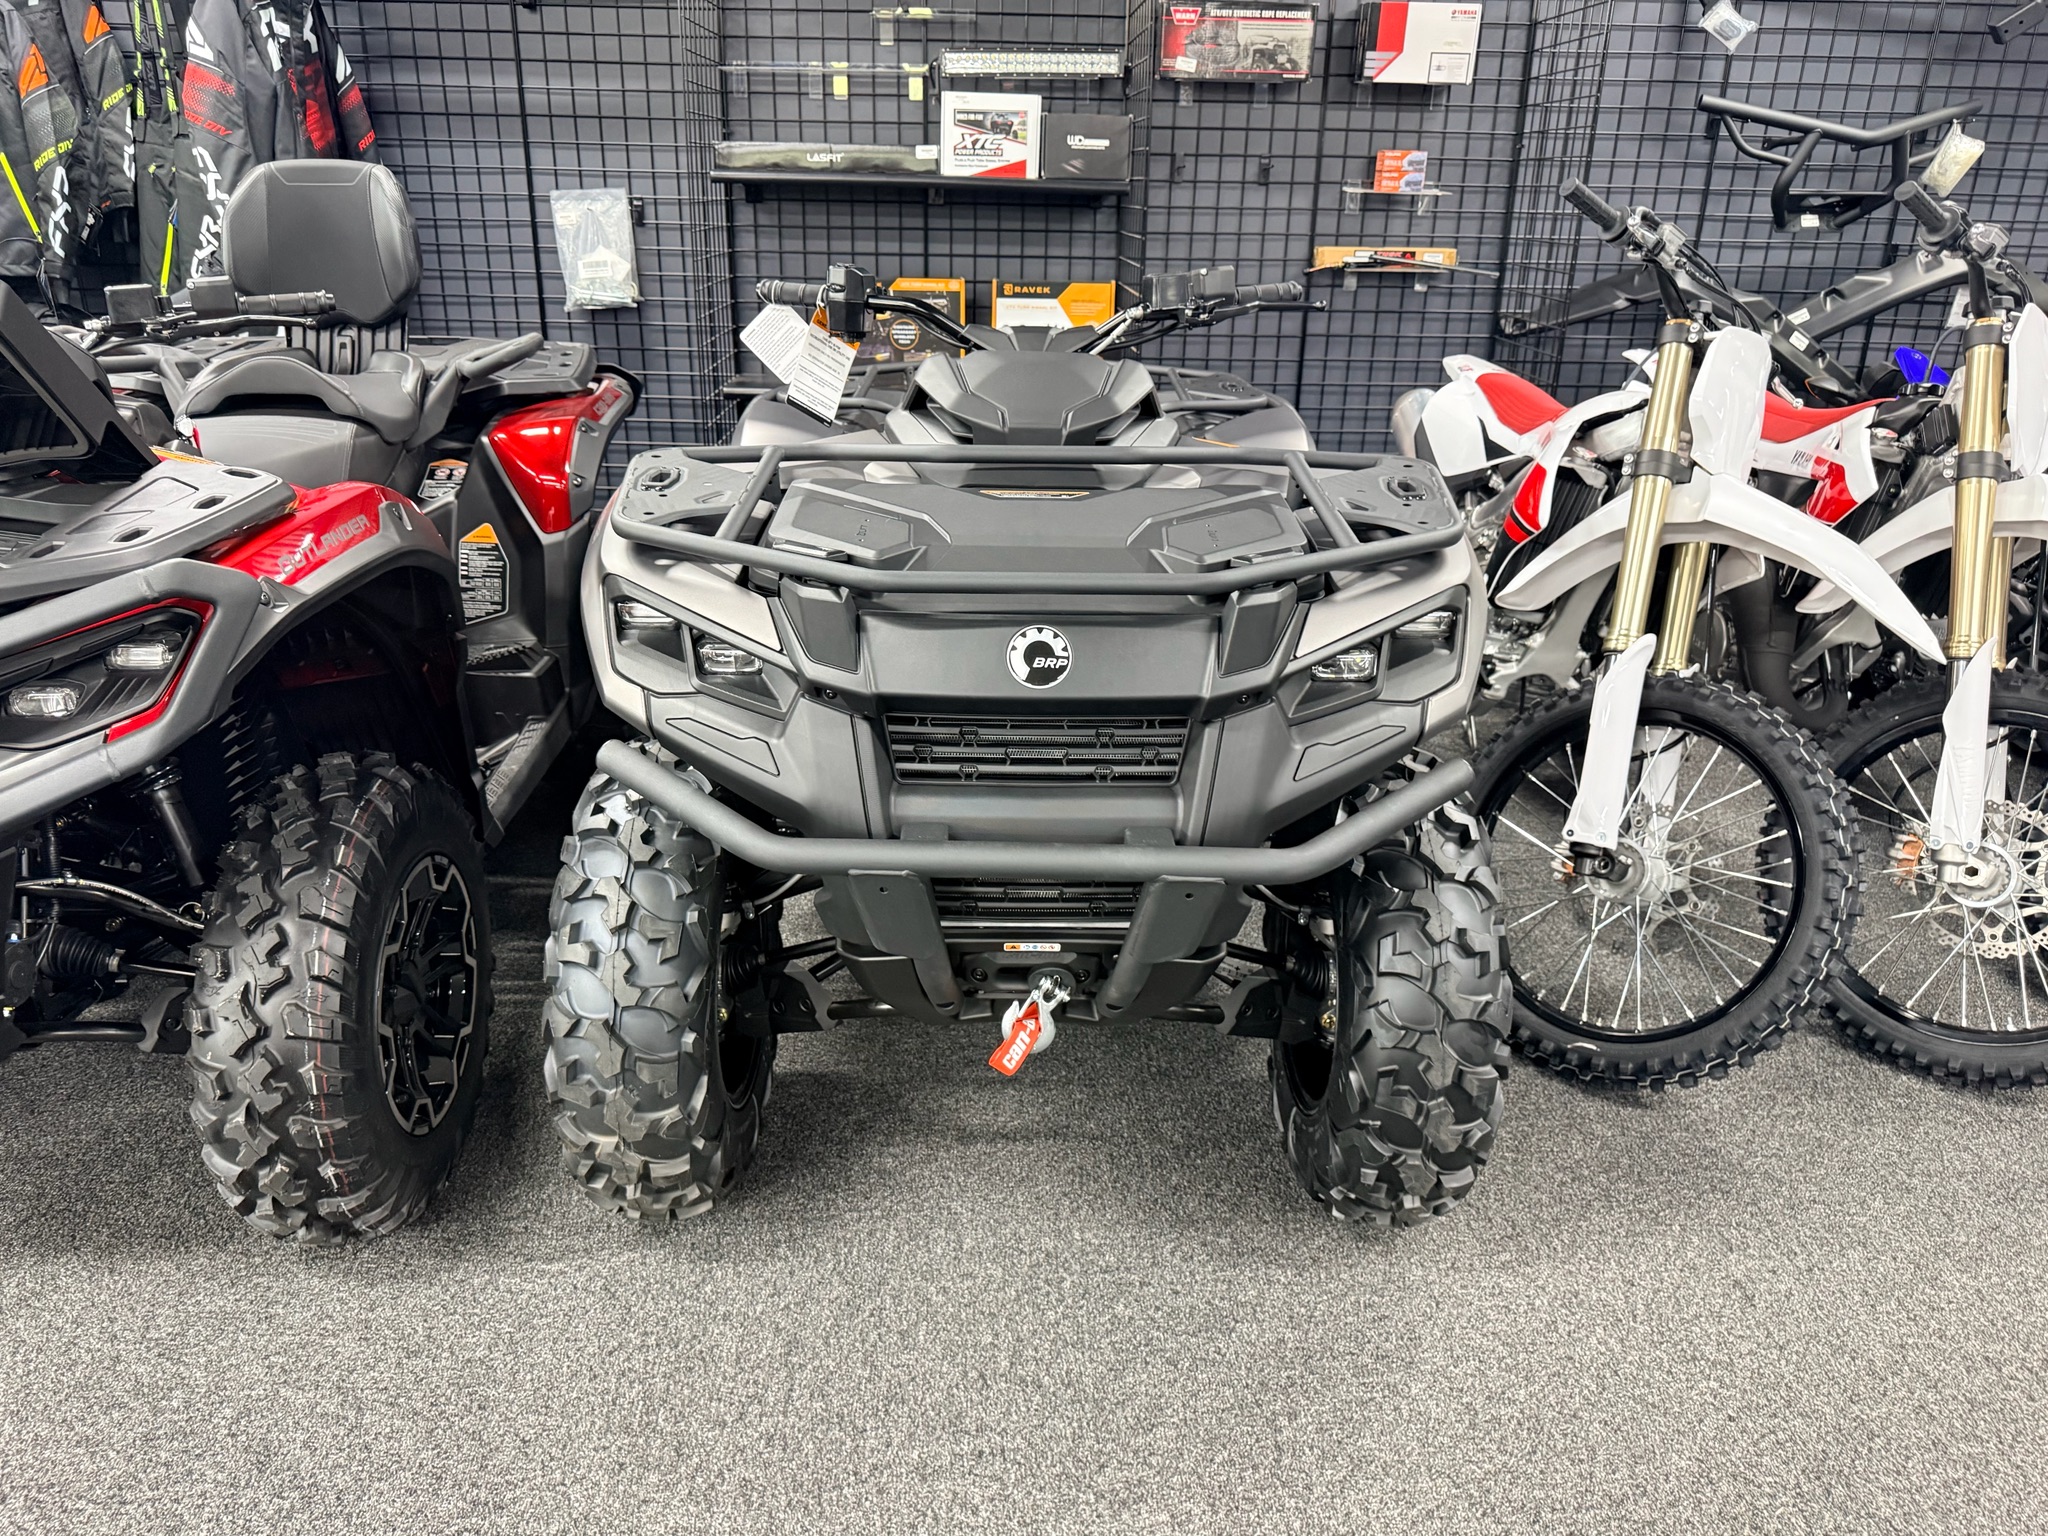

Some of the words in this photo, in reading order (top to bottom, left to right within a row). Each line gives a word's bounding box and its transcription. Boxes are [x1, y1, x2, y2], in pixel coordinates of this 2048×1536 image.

[102, 87, 126, 112] RIDE
[203, 119, 233, 136] DIV
[955, 133, 1006, 150] XTC
[33, 146, 57, 172] RIDE
[57, 138, 74, 154] DIV
[806, 152, 842, 163] LASFIT
[1014, 285, 1051, 294] RAVEK
[277, 513, 371, 576] OUTLANDER
[1032, 656, 1069, 670] BRP
